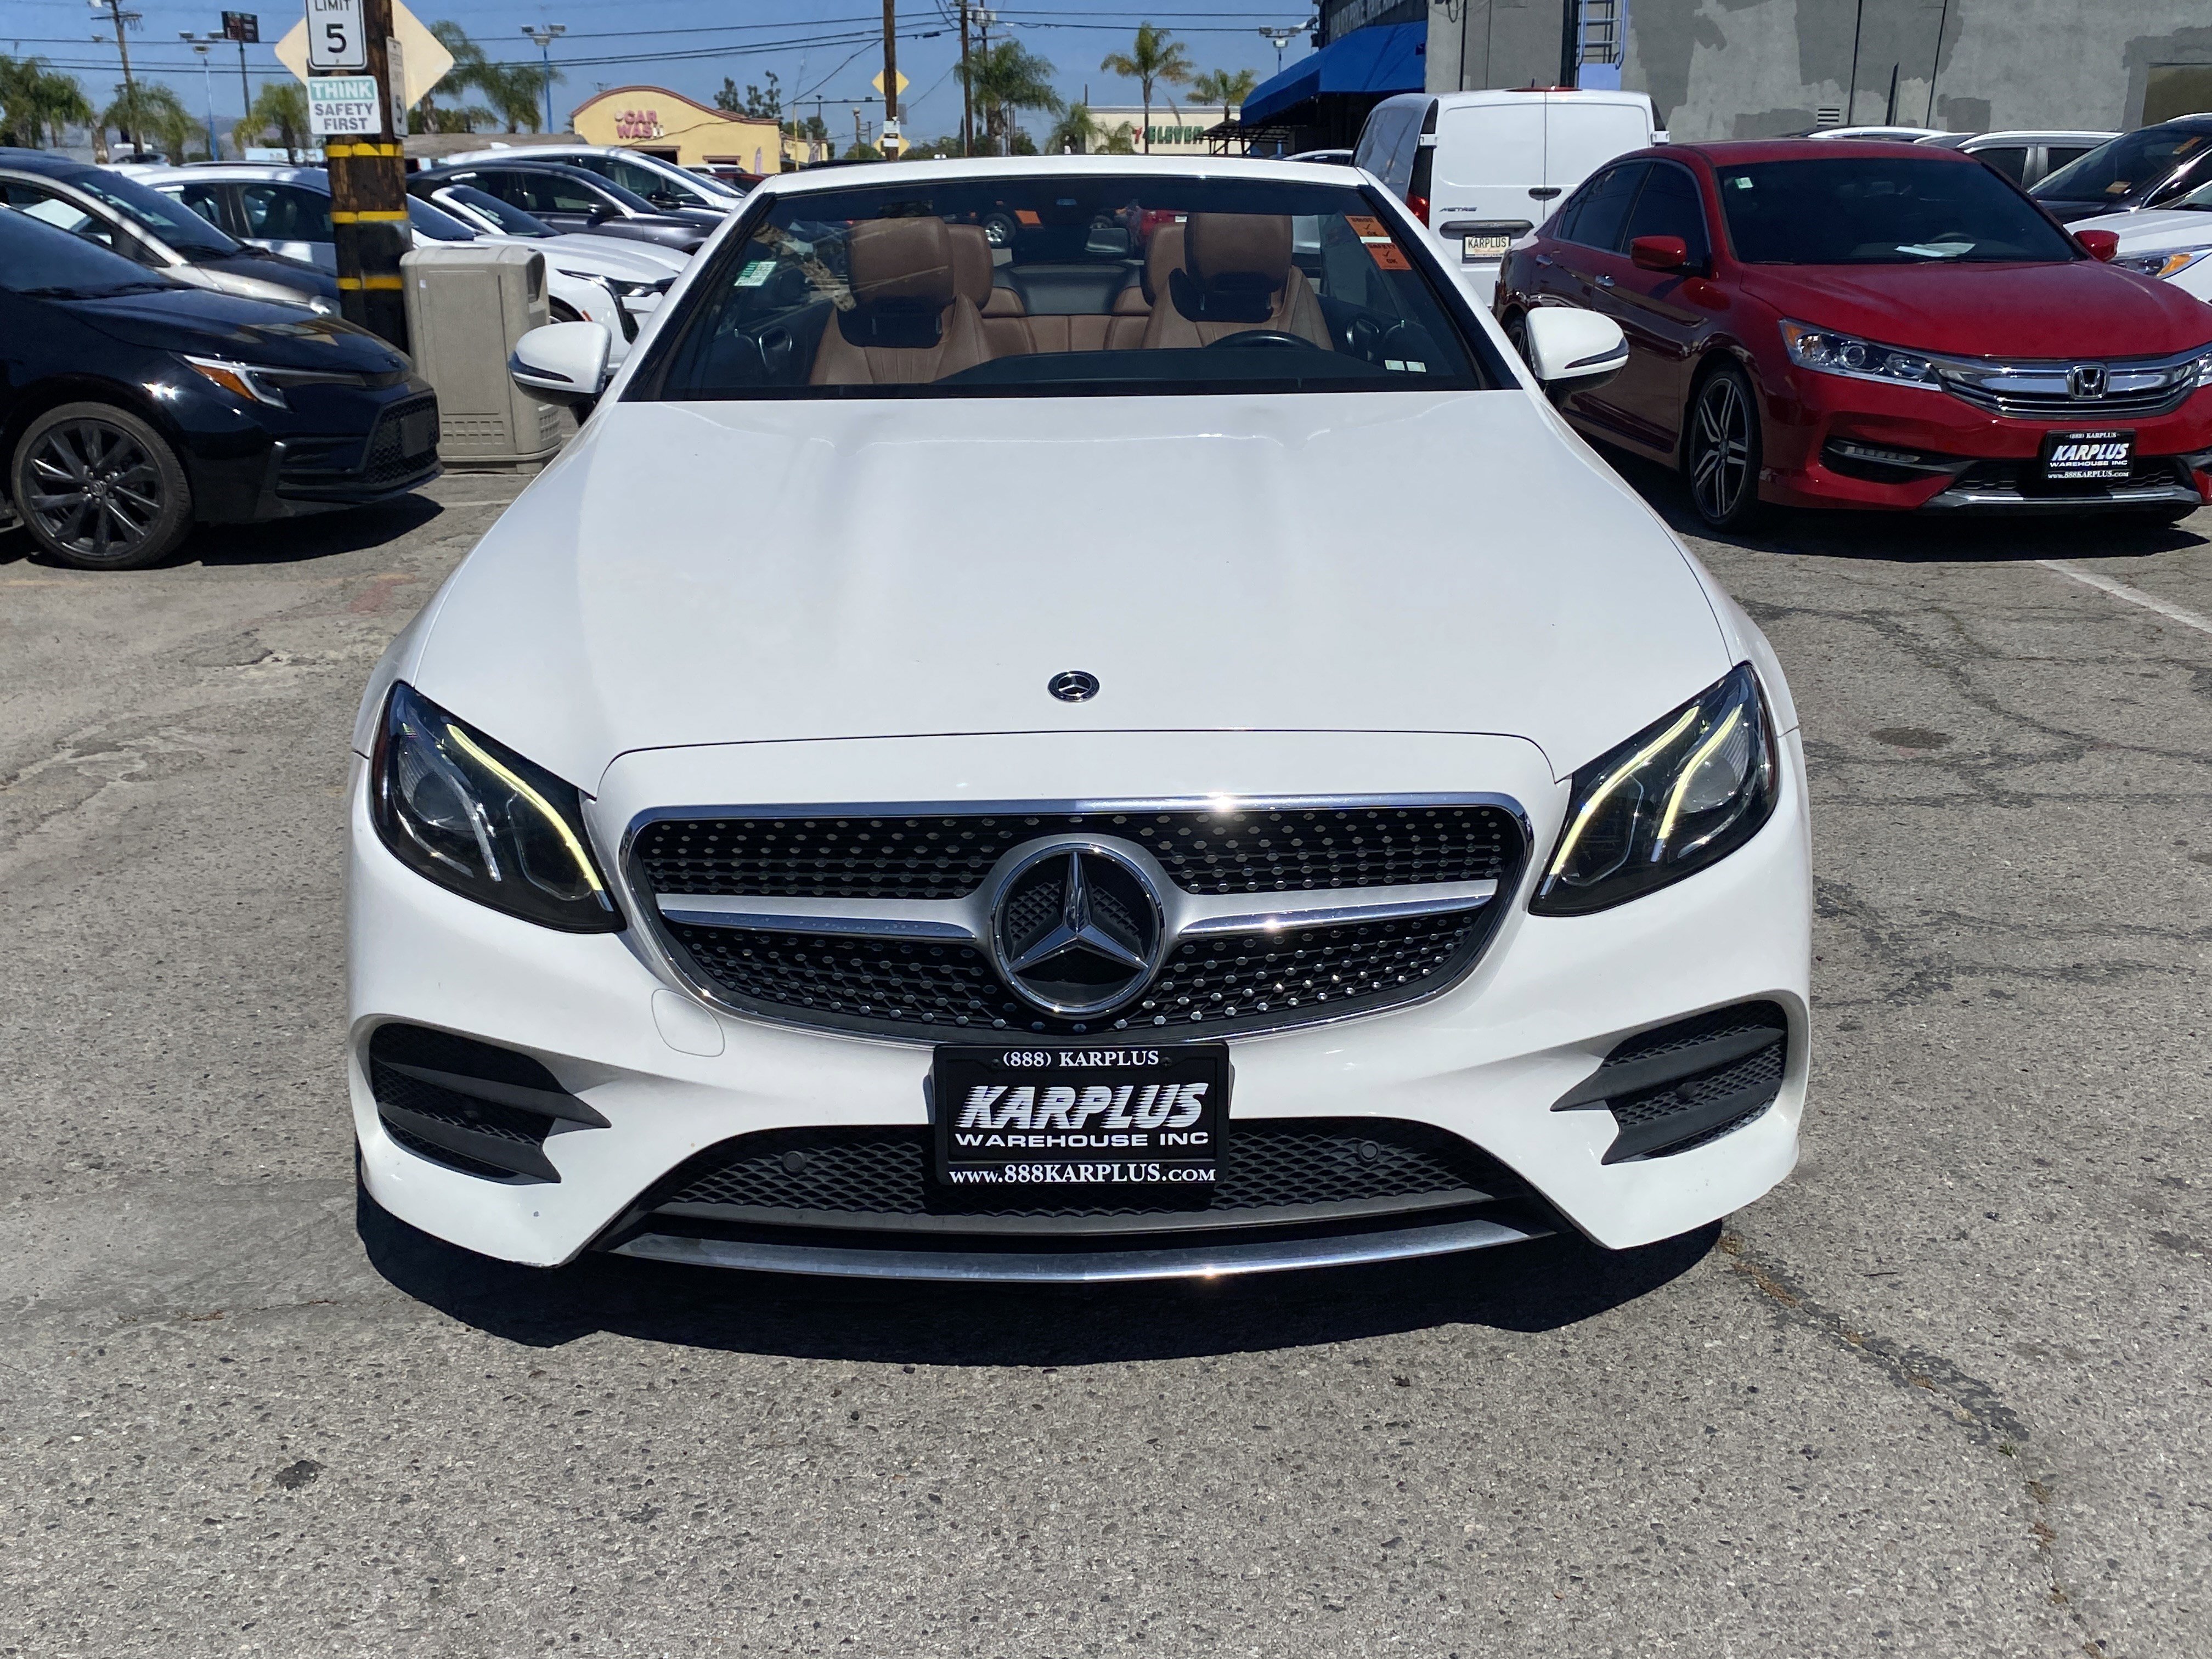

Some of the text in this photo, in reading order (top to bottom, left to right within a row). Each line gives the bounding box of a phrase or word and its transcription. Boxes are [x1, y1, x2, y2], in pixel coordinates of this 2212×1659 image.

[315, 0, 349, 11] LIMIT
[326, 23, 347, 53] 5
[311, 82, 373, 99] THINK
[314, 103, 374, 116] SAFETY
[624, 110, 658, 125] CAR
[324, 117, 368, 131] FIRST
[616, 124, 664, 139] WASH
[1468, 236, 1507, 249] KARPLUS
[2051, 443, 2130, 461] KARPLUS
[1003, 1050, 1159, 1067] (888) KARPLUS
[955, 1082, 1209, 1129] KARPLUS
[955, 1131, 1209, 1148] WAREHOUSE INC
